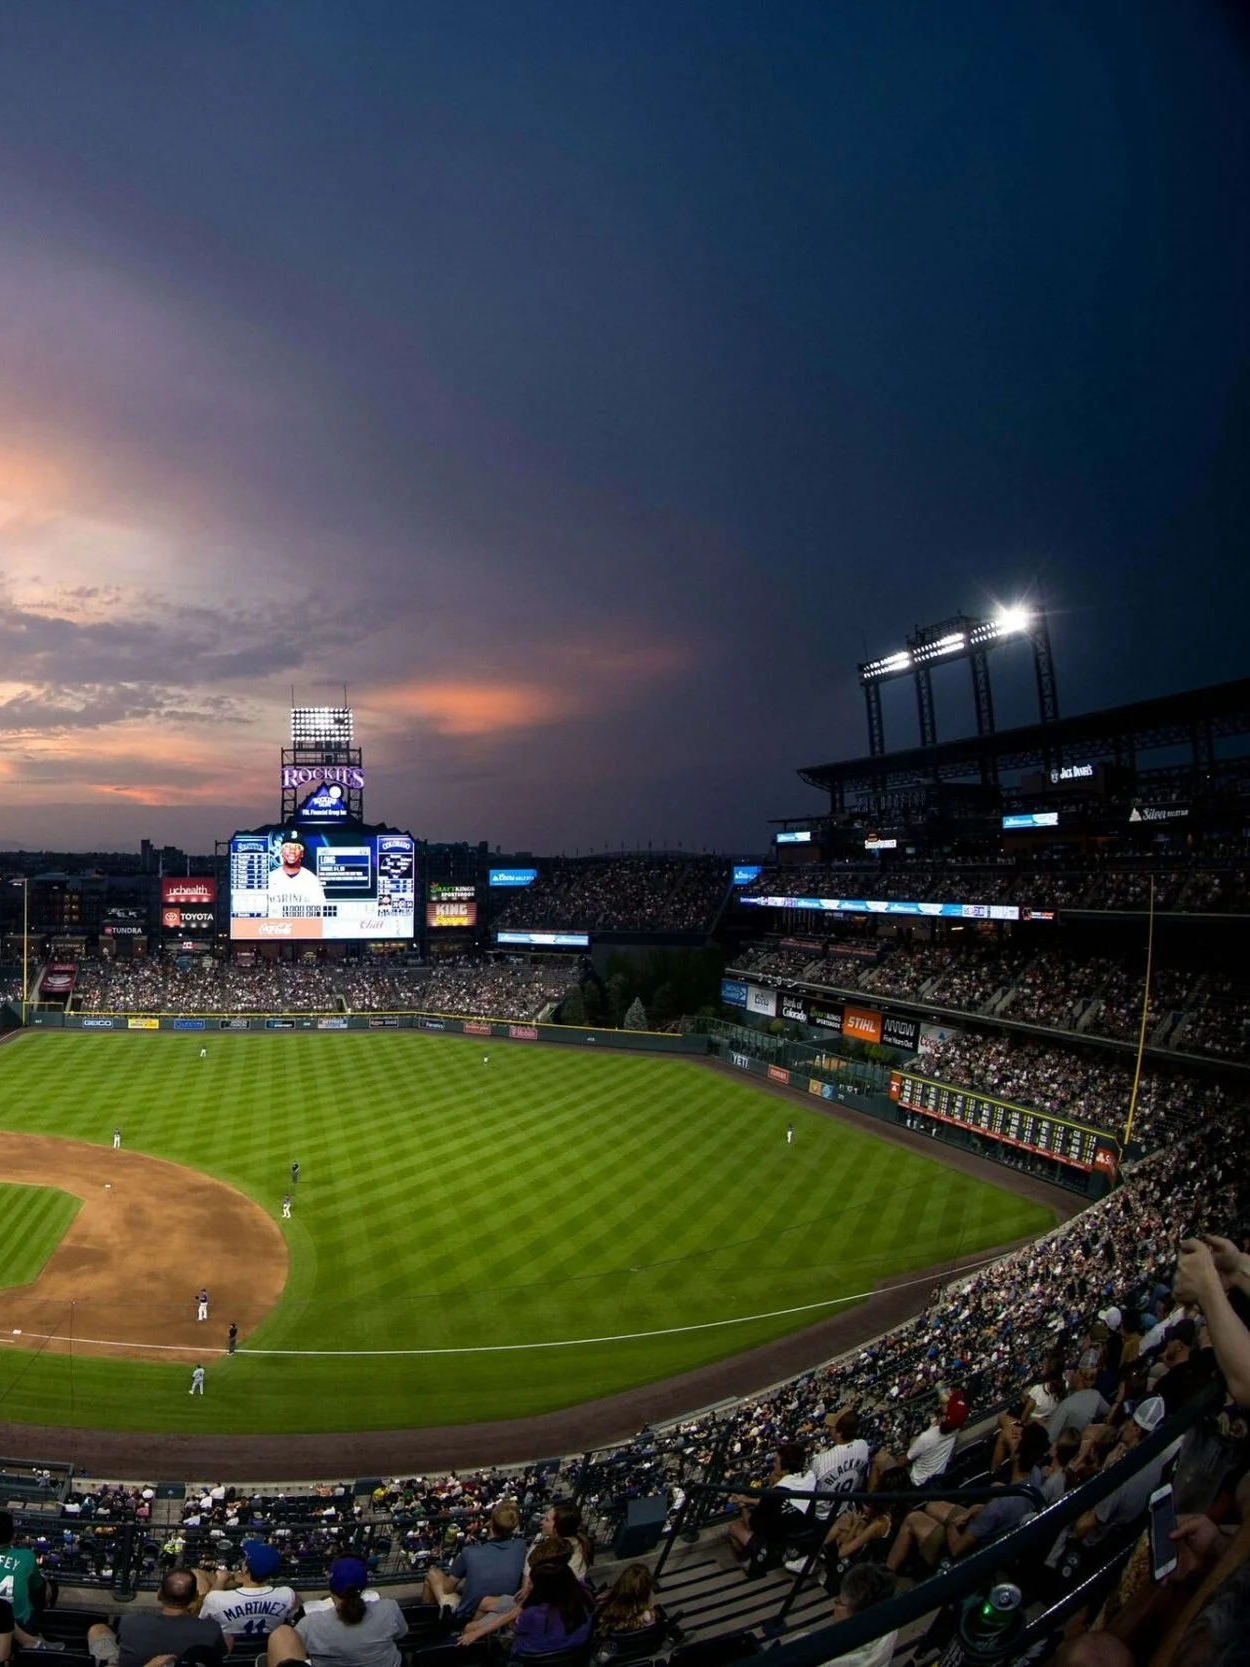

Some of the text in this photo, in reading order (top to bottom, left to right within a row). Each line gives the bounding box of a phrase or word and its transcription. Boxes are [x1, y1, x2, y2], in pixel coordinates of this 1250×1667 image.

[282, 767, 364, 789] ROCKIES
[1060, 767, 1073, 779] JACK
[320, 856, 336, 864] LONG
[169, 885, 208, 895] uchealth
[435, 904, 468, 915] KING
[783, 996, 803, 1010] Bank of
[782, 1006, 807, 1021] Colorado
[847, 1016, 876, 1033] STIHL
[883, 1034, 892, 1042] Five
[732, 1053, 749, 1069] YETI
[223, 1601, 287, 1622] MARTINEZ
[243, 1619, 267, 1633] 11
